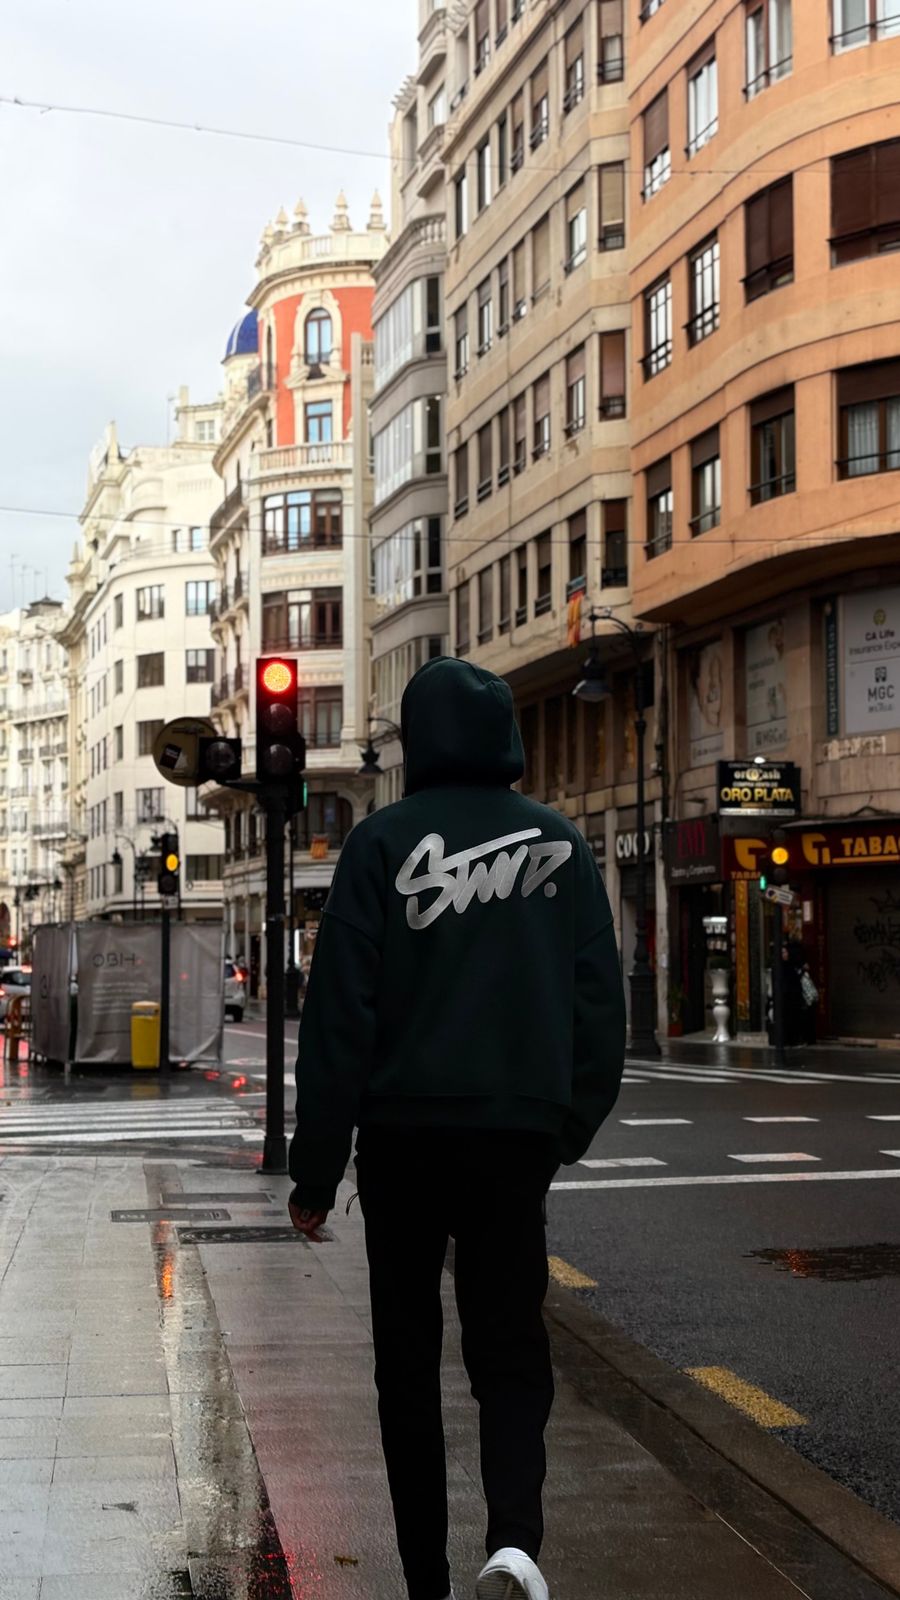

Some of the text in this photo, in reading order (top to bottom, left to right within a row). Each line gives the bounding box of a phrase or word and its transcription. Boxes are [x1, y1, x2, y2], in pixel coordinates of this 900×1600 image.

[867, 684, 895, 702] MGC
[721, 787, 794, 802] ORO PLATA
[841, 835, 900, 857] TABA
